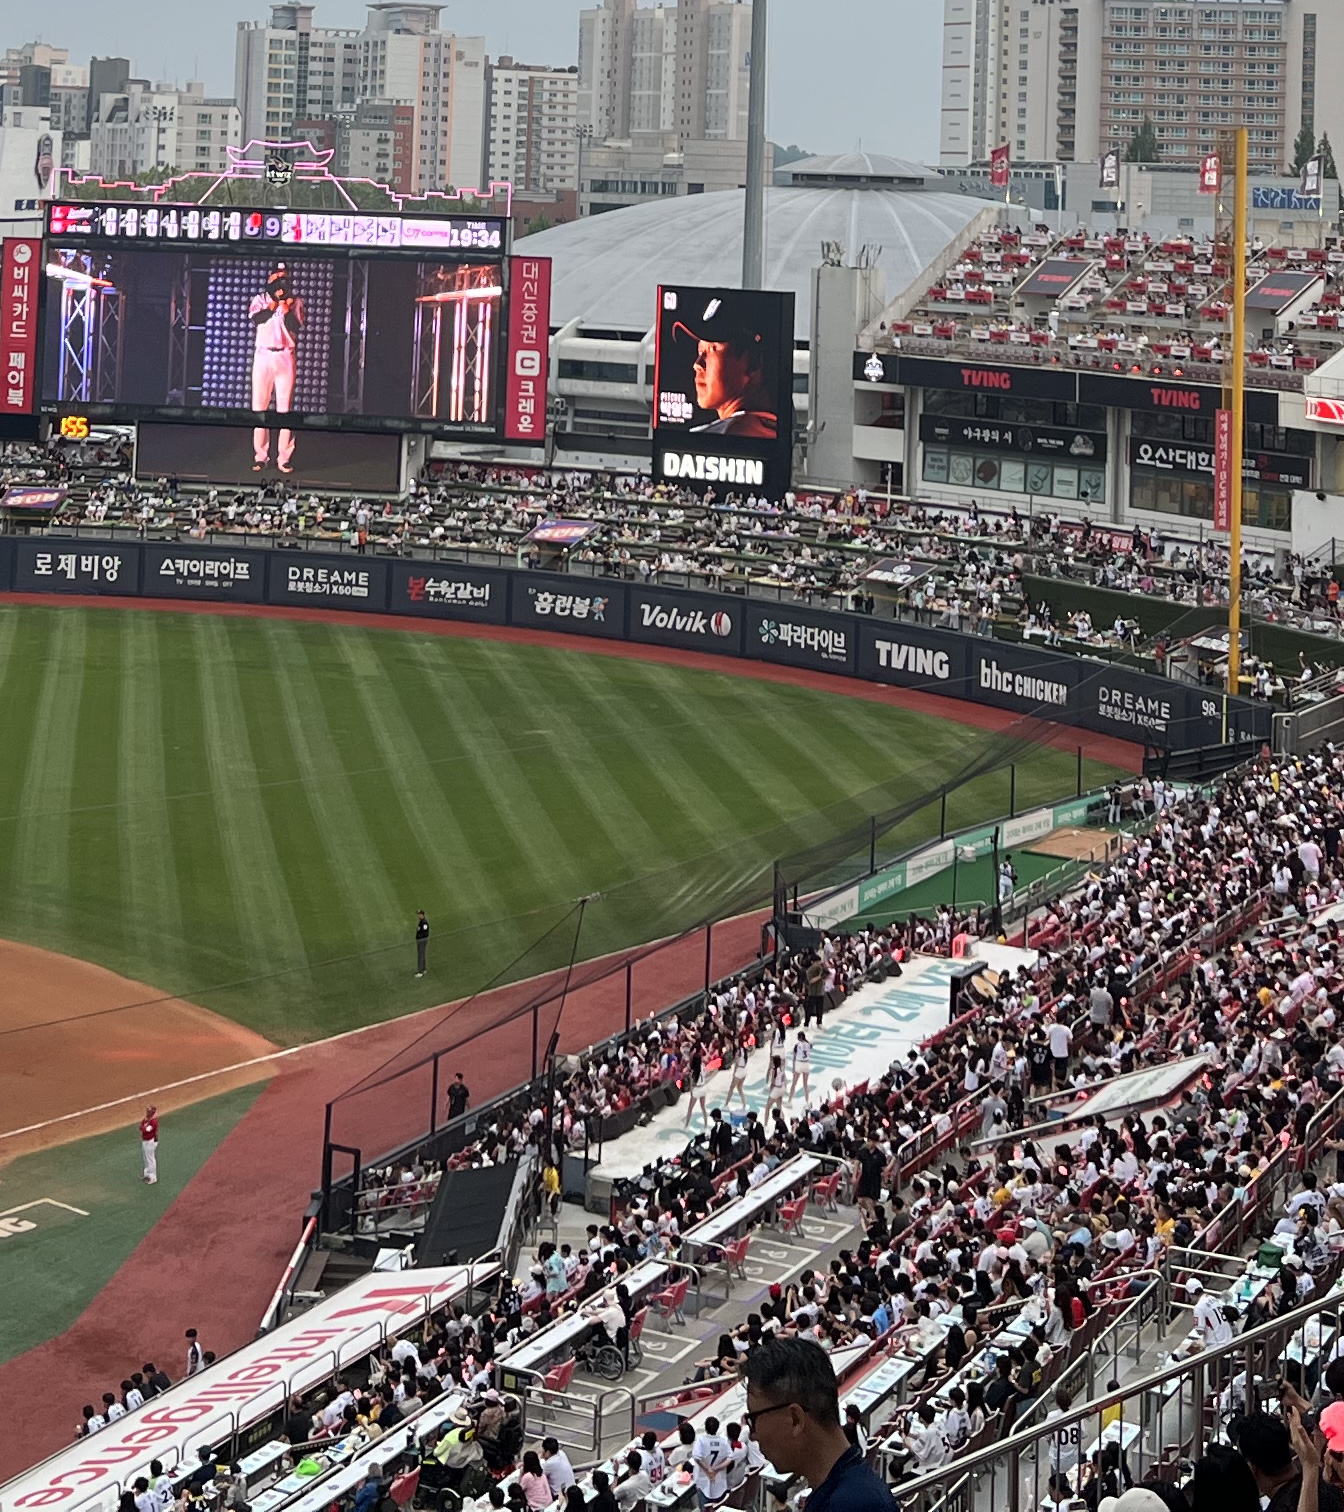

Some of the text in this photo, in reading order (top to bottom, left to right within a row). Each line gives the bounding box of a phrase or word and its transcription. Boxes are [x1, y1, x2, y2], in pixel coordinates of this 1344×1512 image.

[450, 229, 501, 248] 19:34
[7, 266, 29, 407] 비씨카드 페이북
[517, 262, 539, 433] 대신증권 크레온
[960, 369, 1011, 390] TVING
[1150, 388, 1201, 410] TVING
[662, 451, 764, 485] DAISHIN
[34, 553, 122, 582] 로제비앙
[160, 557, 250, 580] 스카이라이프
[288, 566, 370, 586] DREAME
[287, 581, 331, 595] 로봇청소기
[407, 575, 490, 602] 본수원갈비
[641, 603, 707, 634] Volvik
[875, 639, 950, 680] TVING
[980, 658, 1068, 706] bhc CHICKEN
[1098, 686, 1171, 719] DREAME
[12, 1282, 457, 1509] K intelligence
[709, 1450, 719, 1466] 7
